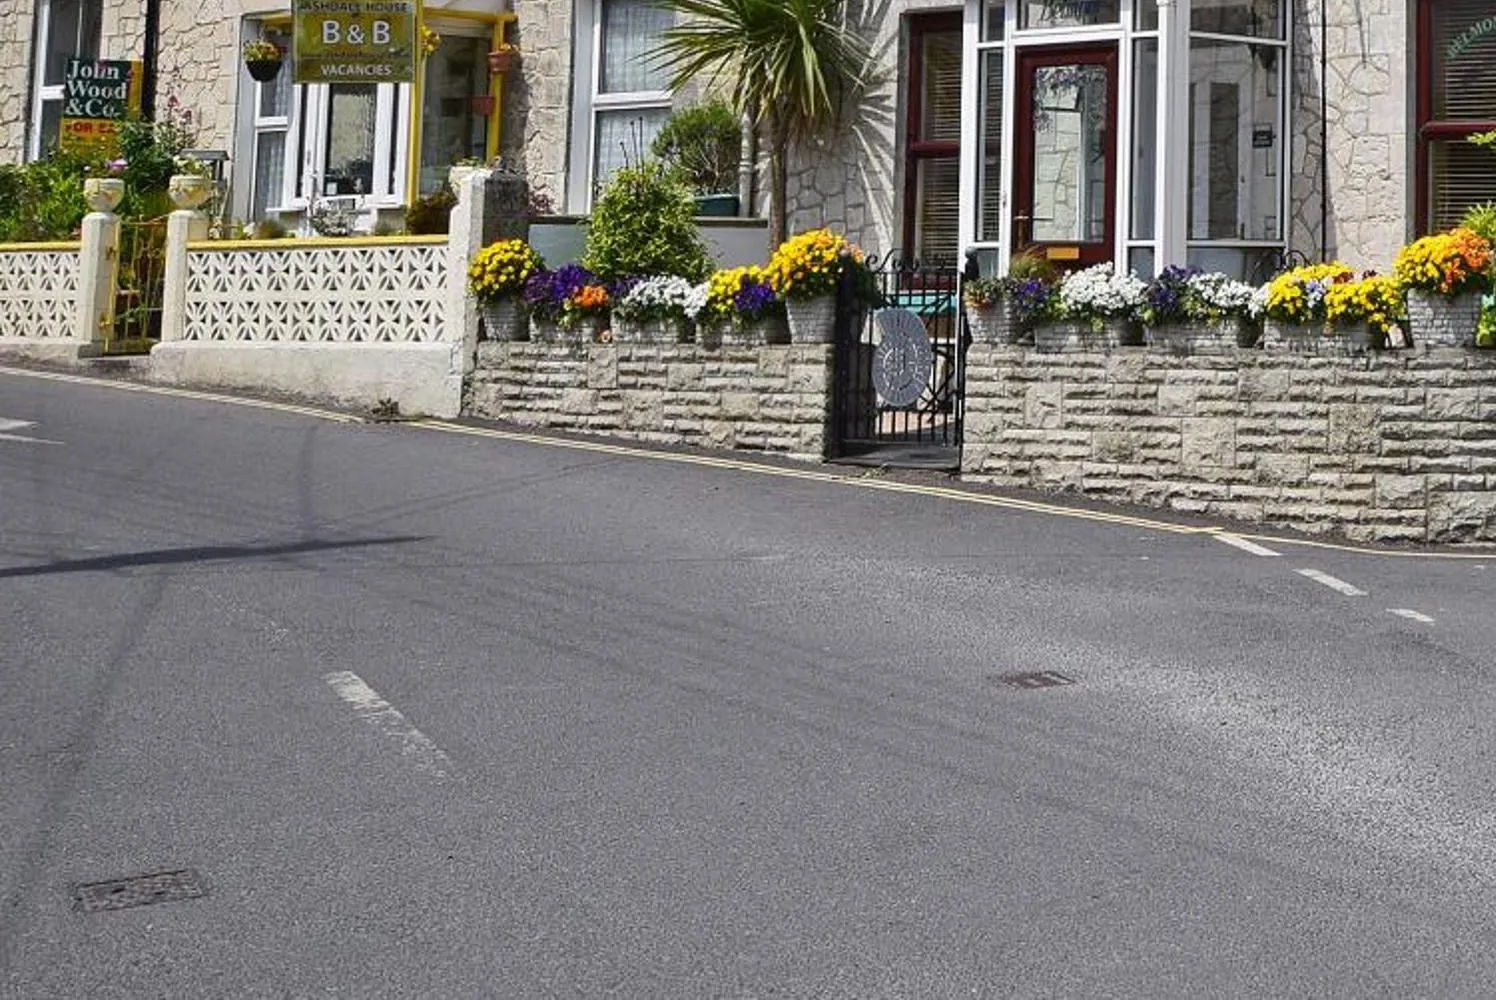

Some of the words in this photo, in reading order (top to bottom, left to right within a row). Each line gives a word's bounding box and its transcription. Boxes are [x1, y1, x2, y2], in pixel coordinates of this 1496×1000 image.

[366, 2, 409, 13] HOUSE
[322, 19, 340, 44] B
[346, 23, 365, 44] &
[372, 19, 390, 44] B
[66, 60, 119, 79] John
[320, 63, 392, 76] VACANCIES
[68, 80, 127, 99] Wood
